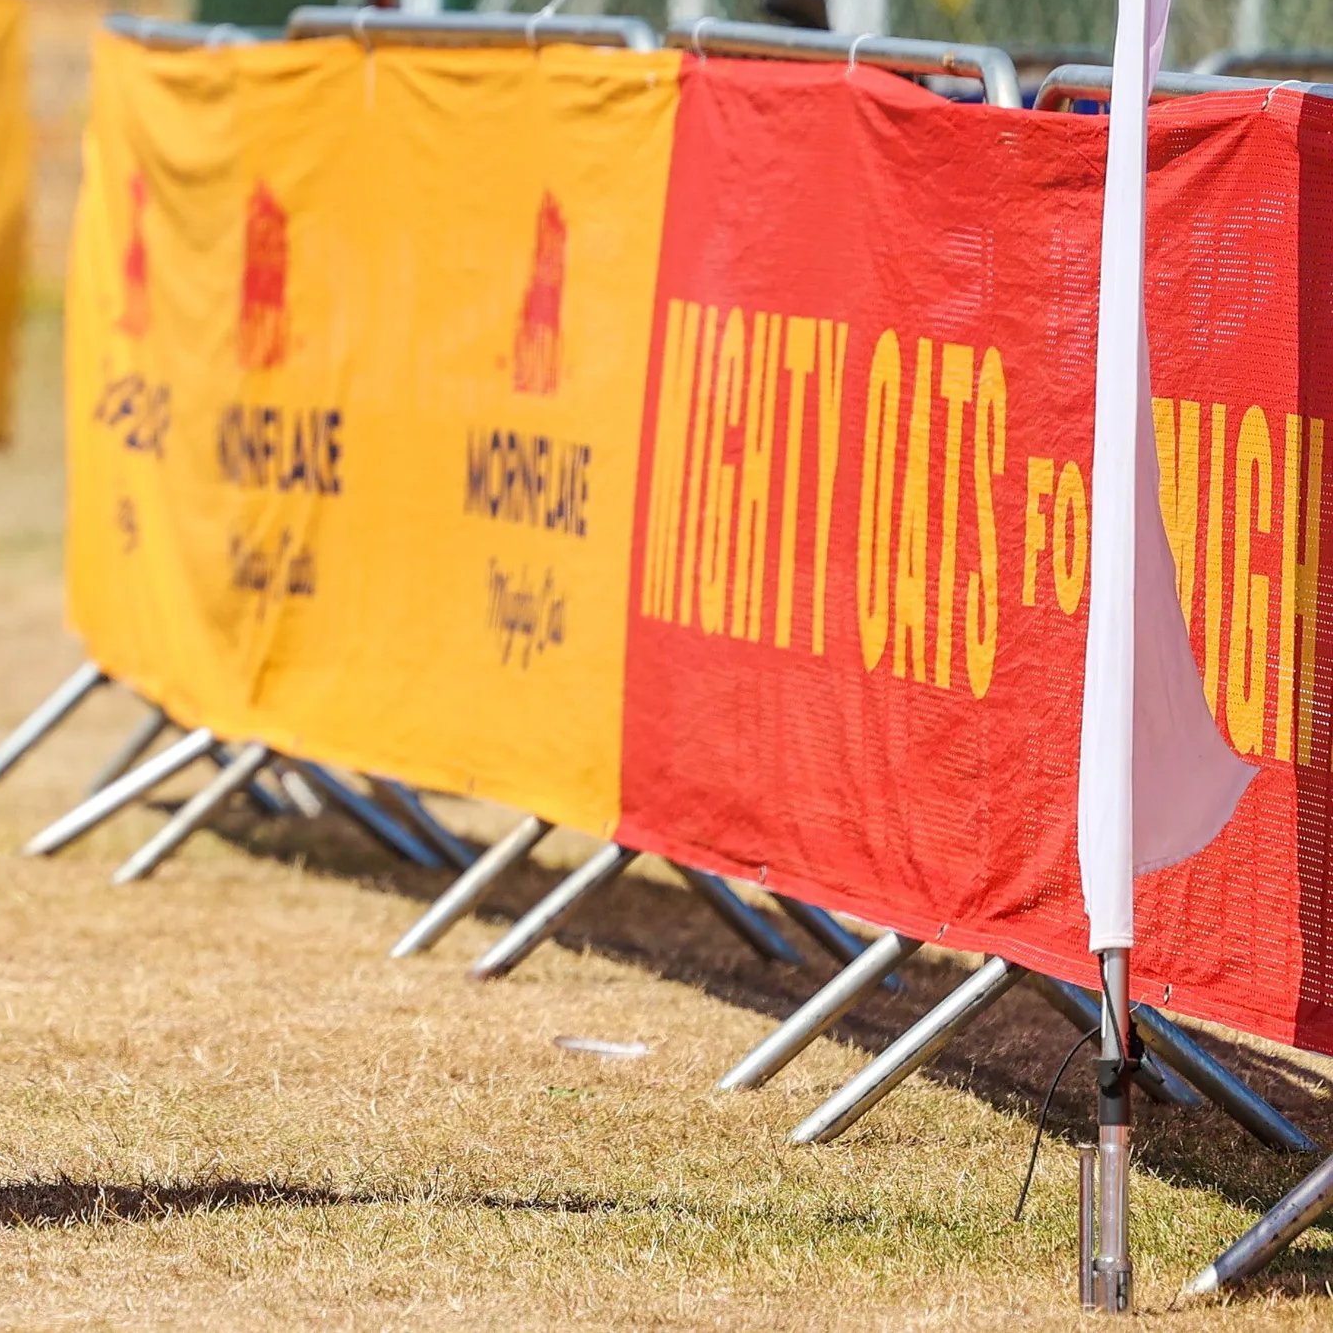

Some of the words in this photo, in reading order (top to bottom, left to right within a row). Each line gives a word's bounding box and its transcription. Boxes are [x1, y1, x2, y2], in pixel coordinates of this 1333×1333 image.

[640, 297, 850, 656] MIGHTY
[855, 328, 1008, 700] OATS
[1022, 454, 1089, 617] FO
[1151, 397, 1325, 766] MIGH
